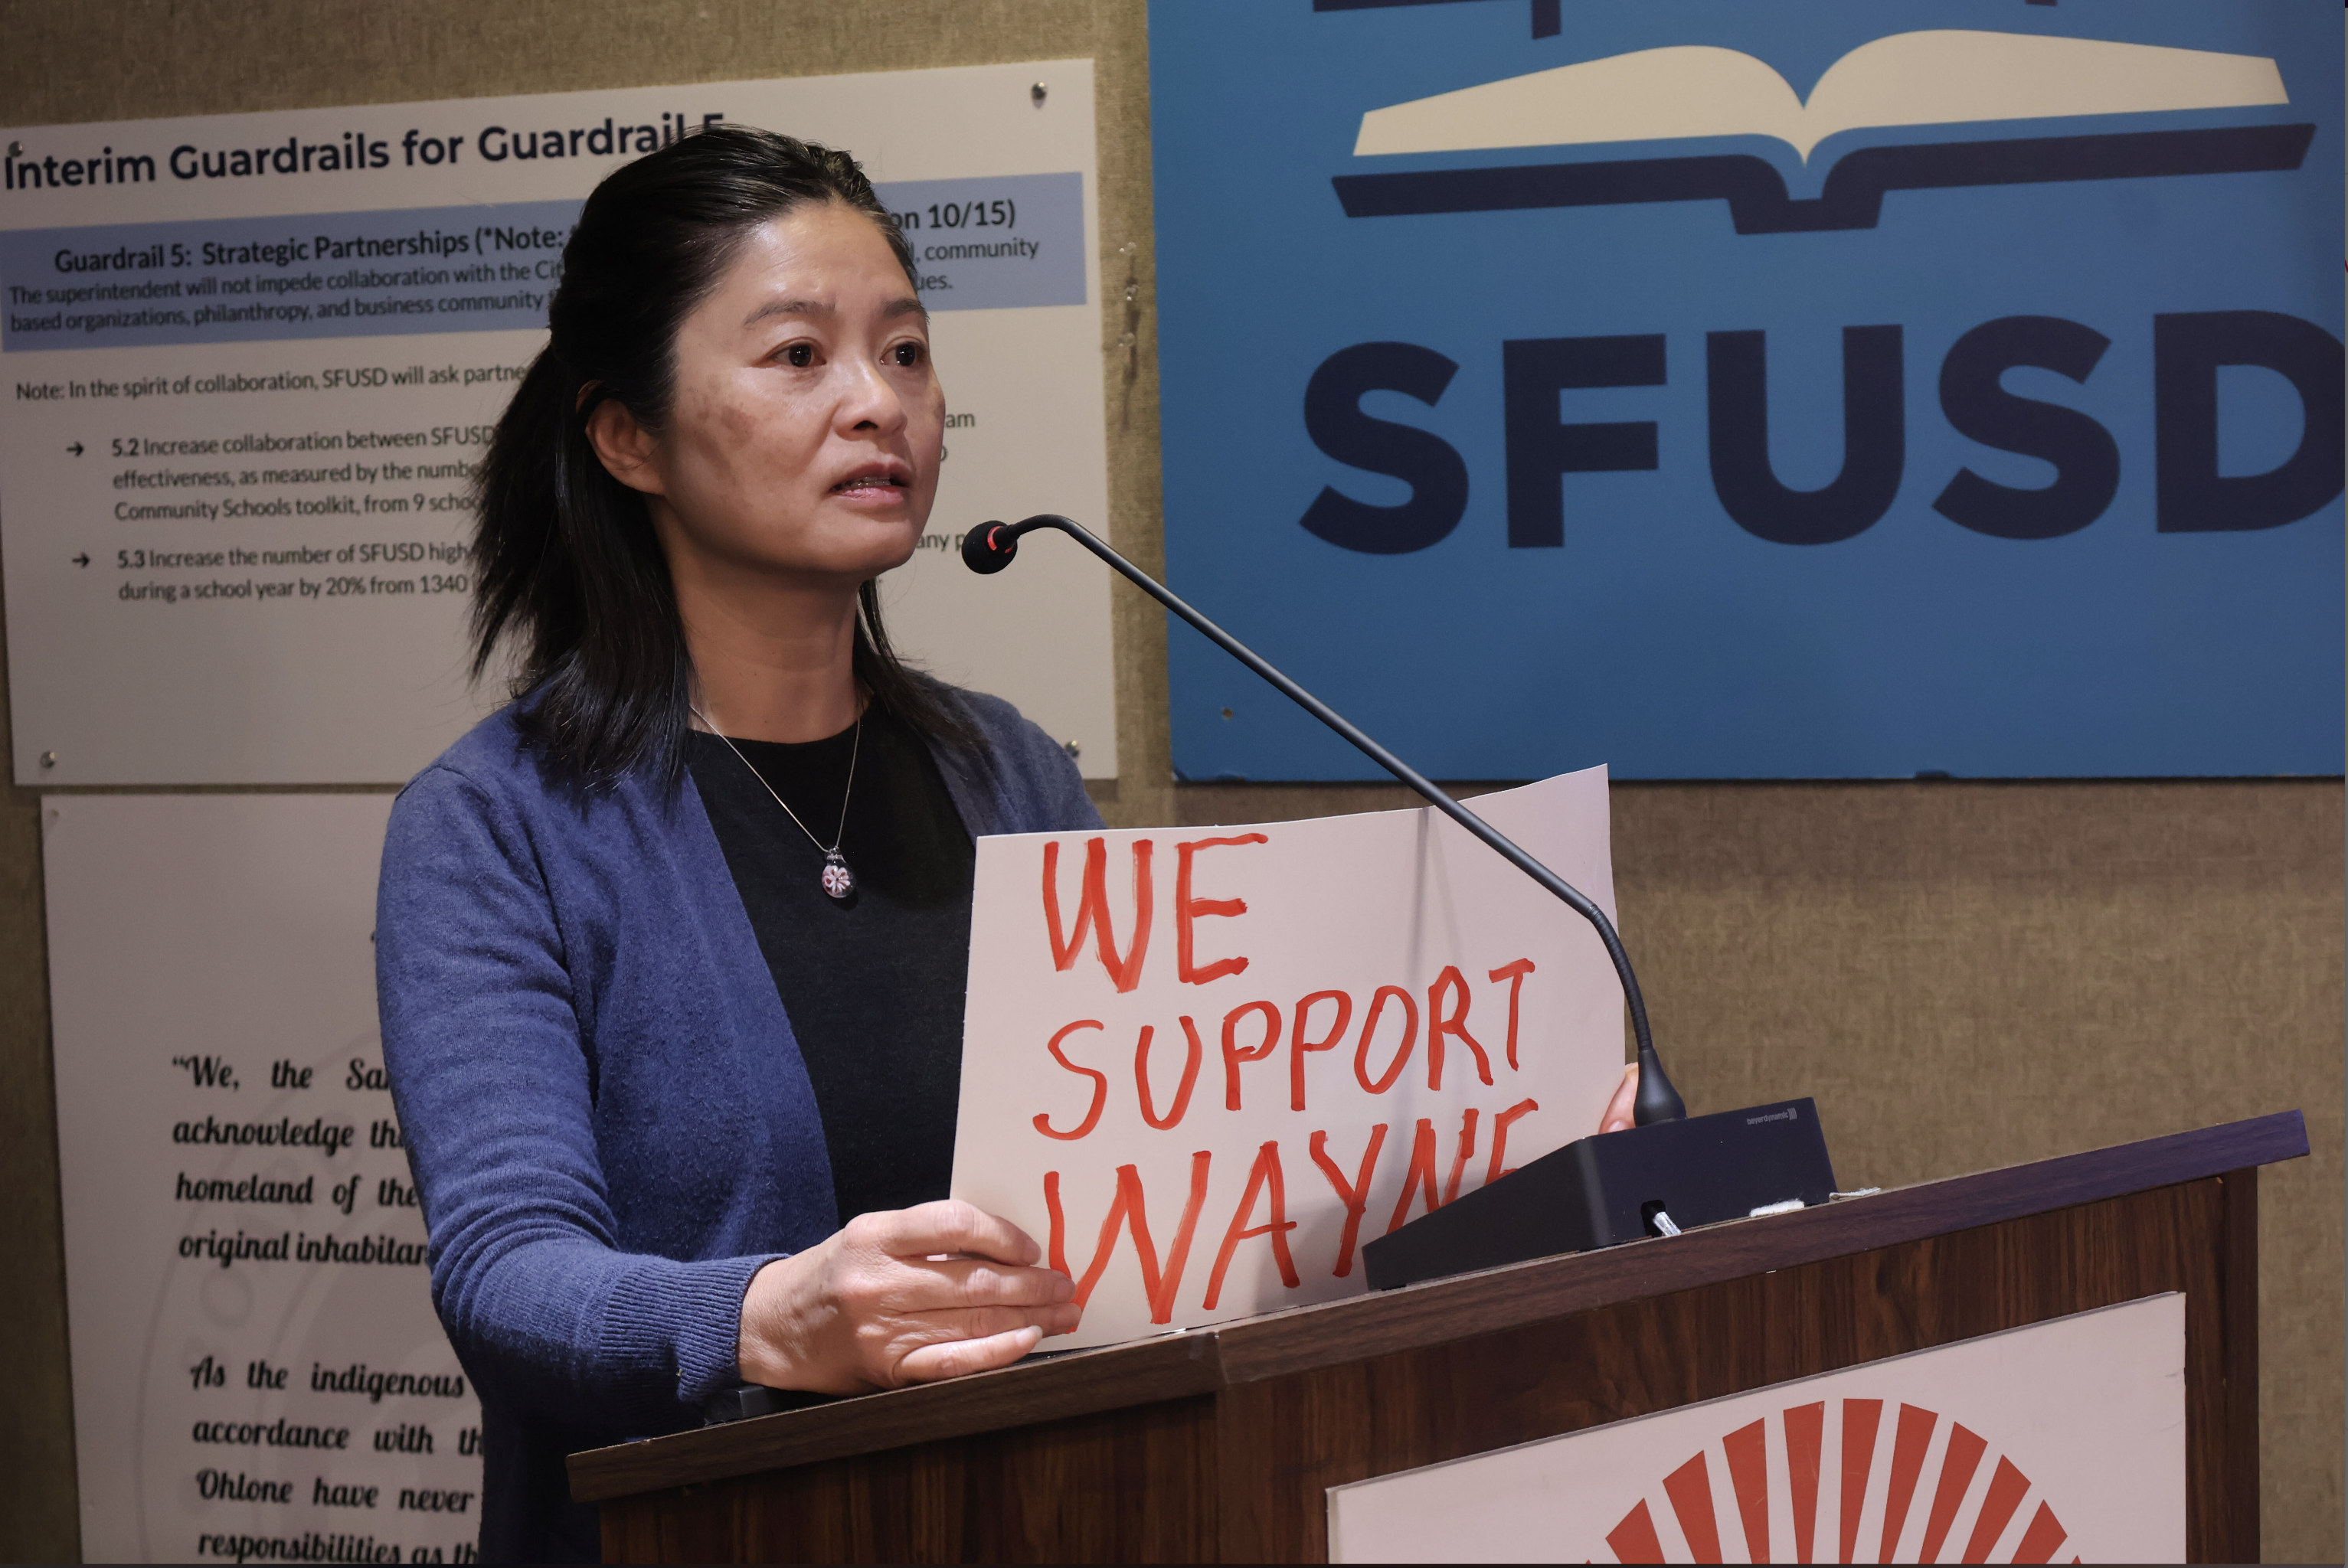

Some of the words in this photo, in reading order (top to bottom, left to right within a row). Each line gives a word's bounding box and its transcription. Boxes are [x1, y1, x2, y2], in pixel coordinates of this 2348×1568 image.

[5, 147, 156, 190] Interim
[169, 132, 388, 180] Guardrails
[403, 129, 463, 165] for
[478, 112, 685, 162] Guardrail
[54, 244, 164, 273] Guardrail
[171, 243, 191, 268] 5:
[202, 237, 308, 266] Strategic
[315, 230, 469, 259] Partnerships
[891, 210, 919, 229] on
[927, 198, 1016, 229] 10/15)
[10, 286, 41, 305] The
[46, 280, 181, 305] superintendent
[186, 276, 217, 296] will
[221, 276, 251, 293] not
[256, 271, 322, 294] impede
[326, 268, 450, 291] collaboration
[453, 264, 495, 283] with
[499, 262, 531, 281] the
[535, 260, 565, 279] Cit
[924, 237, 1039, 260] community
[11, 311, 62, 332] based
[65, 305, 191, 333] organizations,
[195, 302, 312, 327] philanthropy,
[316, 298, 350, 318] and
[355, 296, 435, 316] business
[437, 289, 544, 314] community
[17, 382, 65, 400] Note:
[70, 381, 87, 397] In
[90, 379, 119, 397] the
[123, 377, 168, 400] spirit
[172, 375, 191, 394] of
[195, 371, 319, 394] collaboration,
[322, 367, 387, 389] SFUSD
[391, 366, 423, 384] will
[428, 364, 459, 384] ask
[113, 438, 139, 457] 5.2
[144, 439, 219, 455] Increase
[222, 432, 342, 454] collaboration
[347, 430, 427, 449] between
[431, 425, 496, 446] SFUSD
[1298, 309, 2345, 556] SFUSD
[113, 469, 234, 489] effectiveness,
[238, 471, 258, 485] as
[263, 462, 352, 485] measured
[356, 462, 378, 484] by
[383, 461, 411, 479] the
[115, 500, 218, 521] Community
[223, 496, 291, 517] Schools
[296, 494, 361, 515] toolkit,
[365, 494, 408, 512] from
[413, 492, 424, 511] 9
[117, 549, 146, 568] 5.3
[150, 550, 224, 567] Increase
[228, 547, 258, 566] the
[262, 544, 330, 564] number
[336, 543, 355, 562] of
[359, 541, 424, 561] SFUSD
[119, 580, 176, 603] during
[180, 585, 191, 599] a
[195, 577, 252, 598] school
[256, 580, 294, 600] year
[299, 576, 321, 598] by
[326, 574, 366, 596] 20%
[371, 574, 414, 593] from
[420, 573, 468, 593] 1340
[1042, 833, 1269, 994] WE
[1032, 959, 1536, 1140] SUPPORT
[271, 1060, 313, 1089] the
[345, 1057, 389, 1090] Sa
[1747, 1110, 1788, 1125] beyerdynamic
[172, 1117, 355, 1156] acknowledge
[175, 1173, 313, 1205] homeland
[332, 1175, 361, 1215] of
[378, 1178, 418, 1207] the
[178, 1232, 289, 1268] original
[191, 1356, 226, 1390] As
[247, 1361, 289, 1390] the
[310, 1362, 464, 1403] indigenous
[192, 1419, 350, 1449] accordance
[374, 1423, 433, 1455] with
[196, 1468, 293, 1504] Ohlone
[313, 1478, 378, 1508] have
[398, 1488, 475, 1513] never
[198, 1532, 401, 1564] responsibilities
[411, 1544, 443, 1564] as
